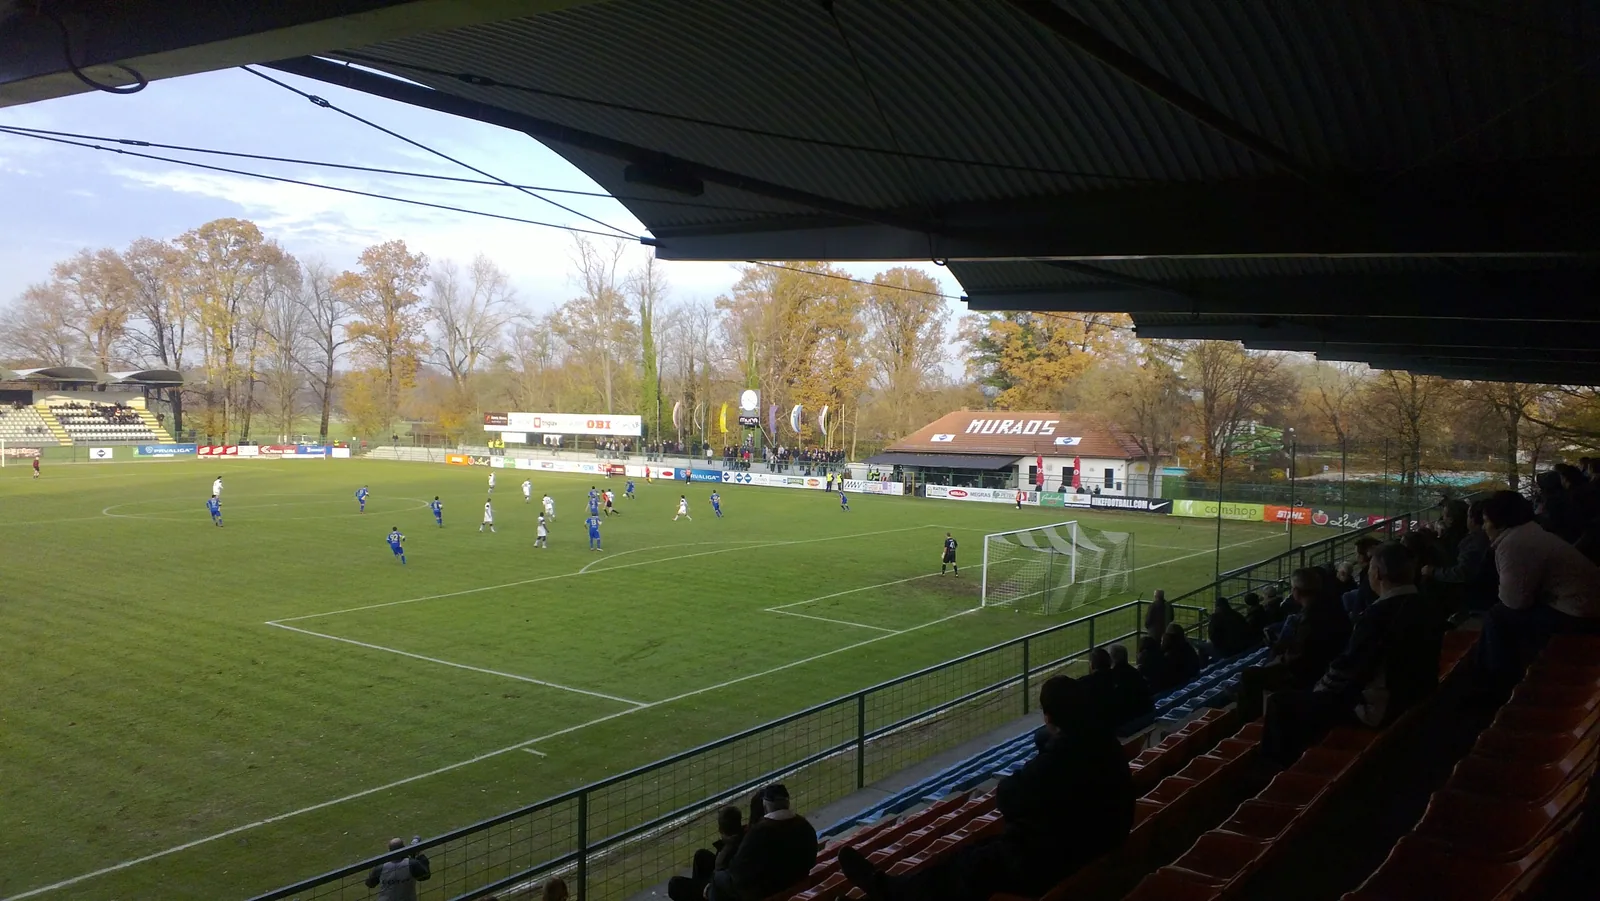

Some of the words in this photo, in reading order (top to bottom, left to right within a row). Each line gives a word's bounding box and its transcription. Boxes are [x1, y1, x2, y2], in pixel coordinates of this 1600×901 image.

[586, 419, 611, 429] OBI
[1092, 497, 1148, 509] NIKEFOOTBALL.COM
[1204, 504, 1257, 518] comshop
[1276, 510, 1305, 520] STIHL
